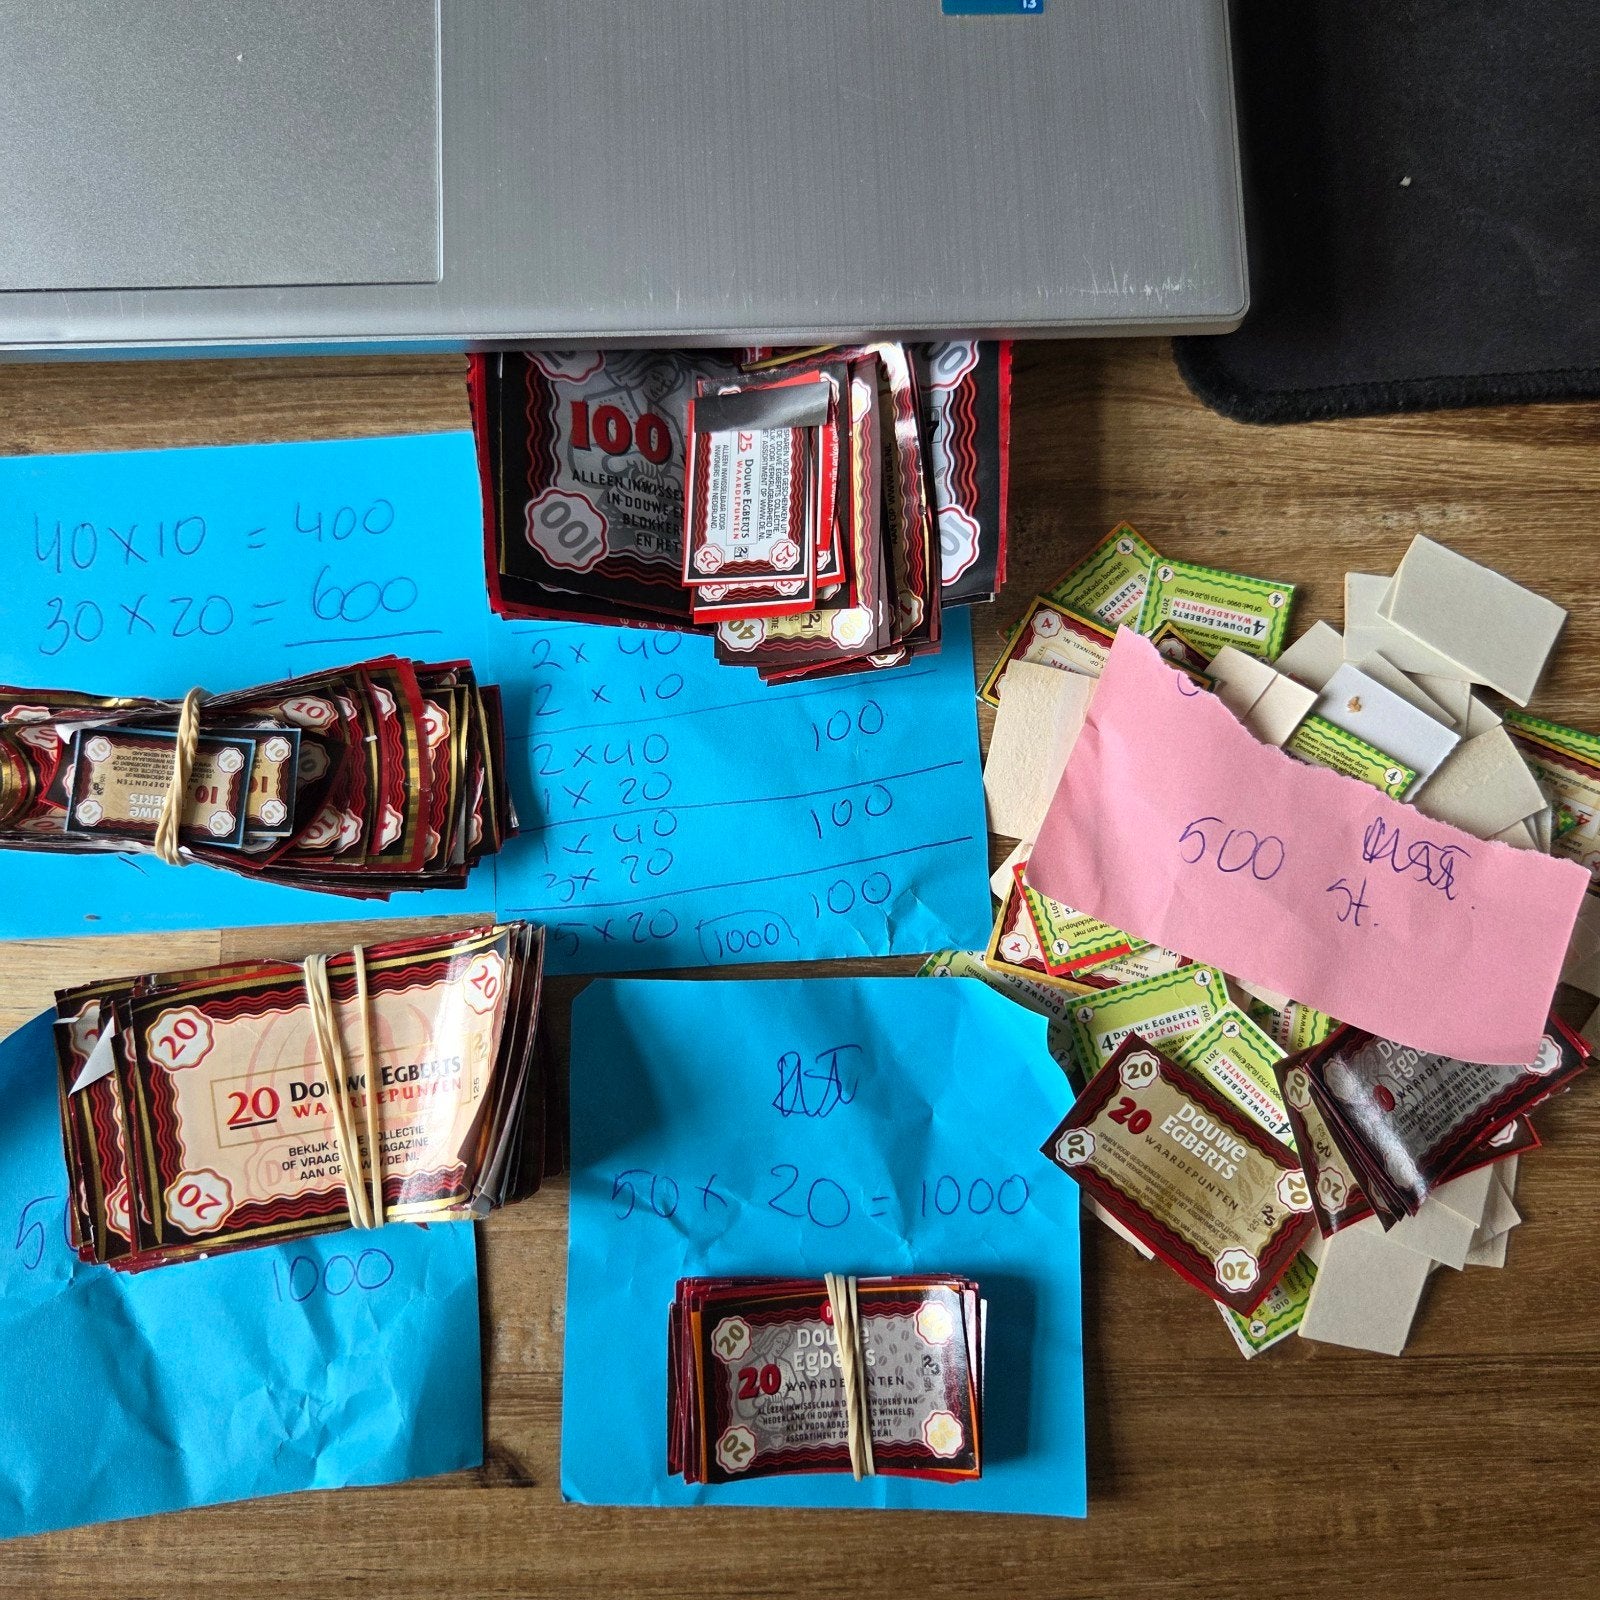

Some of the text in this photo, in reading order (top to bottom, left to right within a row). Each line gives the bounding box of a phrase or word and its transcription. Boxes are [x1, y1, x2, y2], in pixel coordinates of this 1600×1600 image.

[570, 400, 673, 465] 100
[739, 432, 752, 452] 25
[782, 429, 790, 456] SPAREN
[712, 444, 720, 477] INWONERS
[721, 444, 729, 466] ALLEEN
[760, 440, 768, 486] ASSORTIMENT
[781, 456, 789, 475] VOOR
[572, 469, 624, 488] ALLEEN
[719, 467, 727, 507] INWISSELBAAR
[605, 493, 668, 514] IN DOUWE
[732, 460, 743, 539] WAARDEPUNTEN
[760, 488, 767, 497] OP
[764, 463, 774, 527] VERKRIJGBAARHEID
[780, 478, 788, 521] GESCHENKEN
[295, 499, 394, 541] 400
[540, 501, 602, 562] 100
[621, 512, 680, 535] BLOKKER
[635, 532, 679, 553] EN HET
[765, 529, 772, 538] EN
[1121, 541, 1132, 552] 4
[700, 550, 720, 569] 25
[775, 544, 795, 564] 25
[1161, 568, 1170, 580] 4
[39, 597, 104, 655] 30
[170, 595, 234, 637] 20
[312, 565, 418, 622] 600
[1096, 581, 1138, 617] EGBERTS
[1160, 597, 1169, 615] 2012
[1172, 600, 1252, 624] WAARDEPUNTEN
[1271, 593, 1281, 606] 4
[1042, 617, 1053, 629] 4
[1170, 609, 1266, 638] 4 DOUWE EGBERTS
[531, 640, 562, 669] 2
[618, 631, 682, 660] 40
[535, 684, 562, 716] 2
[638, 673, 684, 704] 10
[292, 701, 324, 719] 10
[813, 699, 887, 752] 100
[532, 743, 565, 775] 2
[604, 733, 669, 766] 40
[1299, 731, 1318, 744] Alleen
[1353, 759, 1369, 771] door
[618, 771, 673, 805] 20
[1387, 771, 1398, 782] 4
[194, 785, 218, 804] 10
[811, 784, 893, 840] 100
[304, 815, 335, 840] 10
[613, 810, 677, 844] 40
[1179, 816, 1285, 881] 500
[621, 848, 674, 884] 20
[811, 871, 891, 919] 100
[1049, 900, 1061, 918] 2011
[626, 909, 678, 943] 20
[1009, 940, 1022, 953] 4
[1056, 941, 1066, 953] 4
[469, 966, 498, 1000] 20
[1197, 973, 1207, 984] 4
[1080, 1009, 1090, 1021] 4
[158, 1016, 199, 1059] 20
[1101, 1007, 1197, 1051] 4 EGBERTS
[1225, 1024, 1236, 1034] 4
[1128, 1060, 1152, 1079] 20
[1203, 1048, 1219, 1065] 2011
[1209, 1064, 1249, 1101] EGBERTS
[1216, 1057, 1285, 1122] WAARDEPUNTEN
[1290, 1075, 1307, 1098] 20
[222, 1084, 282, 1125] 20
[290, 1076, 465, 1118] WAREPUNTEN
[1107, 1096, 1153, 1135] 20
[1244, 1098, 1277, 1130] DOUWE
[1274, 1122, 1291, 1137] 4
[288, 1140, 330, 1157] BEKIJK
[1069, 1133, 1085, 1157] 20
[1158, 1113, 1242, 1181] EGBERTS
[281, 1152, 340, 1171] OF VRAAG
[299, 1167, 325, 1180] AAN
[1140, 1134, 1241, 1212] WAARDEPUNTEN
[177, 1183, 222, 1219] 20
[611, 1169, 680, 1220] 50
[767, 1163, 850, 1228] 20
[921, 1173, 1030, 1217] 1000
[1289, 1175, 1309, 1204] 20
[1320, 1176, 1343, 1202] 20
[272, 1247, 394, 1303] 1000
[1222, 1261, 1251, 1281] 20
[1271, 1298, 1290, 1313] 2010
[719, 1327, 744, 1356] 20
[797, 1328, 870, 1347] Doue
[1253, 1325, 1263, 1333] 4
[793, 1348, 876, 1376] Egbes
[738, 1363, 782, 1400] 20
[785, 1375, 905, 1392] WAARDENTEN
[903, 1396, 918, 1405] VAN
[804, 1420, 824, 1431] VOOR
[874, 1419, 892, 1427] HET
[817, 1410, 842, 1420] DOUWE
[723, 1434, 751, 1462] 20
[786, 1431, 836, 1443] ASSORTIMENT
